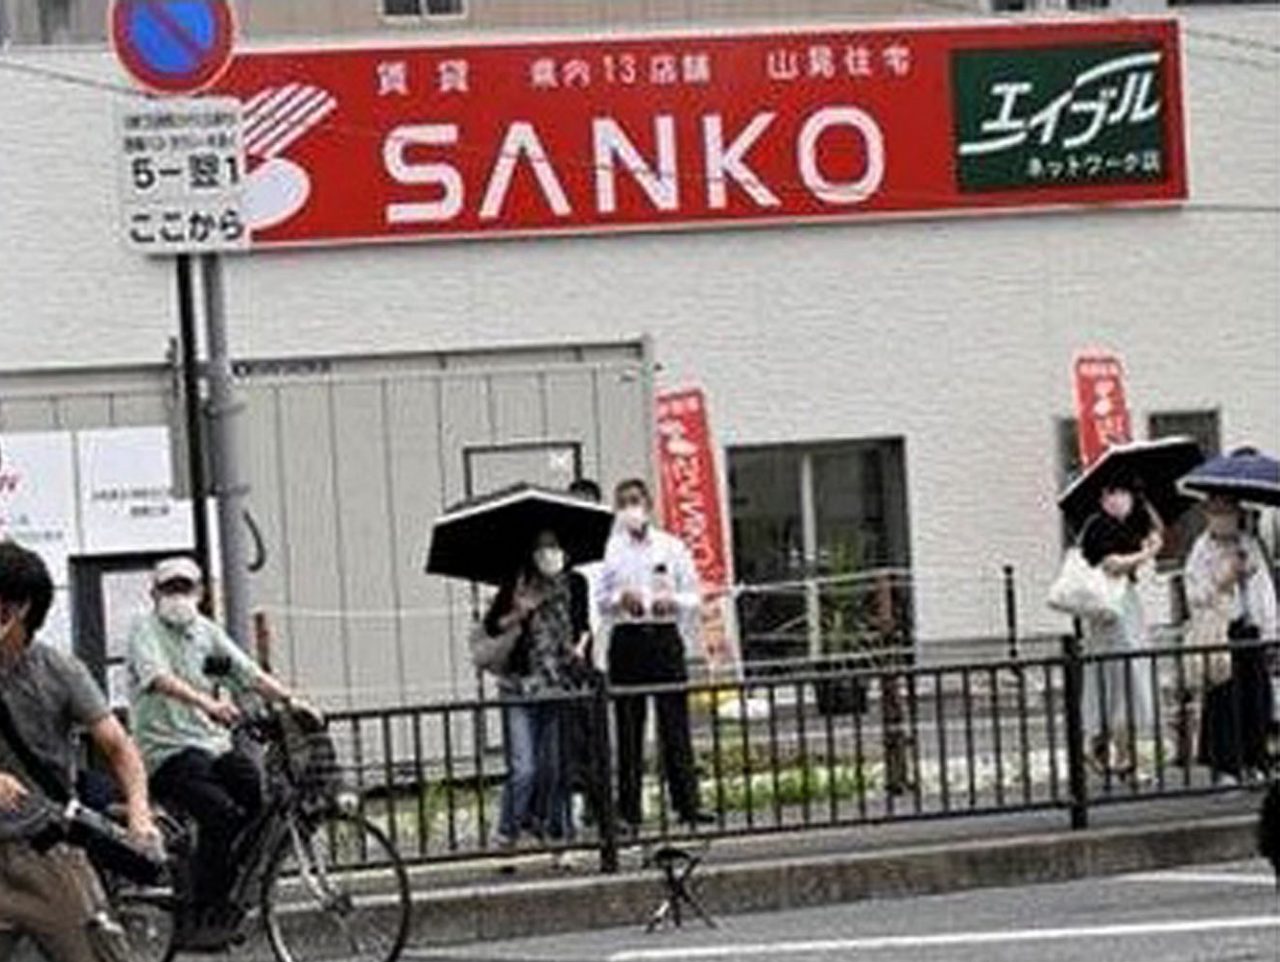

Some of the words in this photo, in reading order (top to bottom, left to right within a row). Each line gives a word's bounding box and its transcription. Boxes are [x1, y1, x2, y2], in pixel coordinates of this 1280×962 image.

[980, 70, 1161, 148] エイブル
[381, 105, 886, 224] SANKO
[129, 209, 244, 244] ここから
